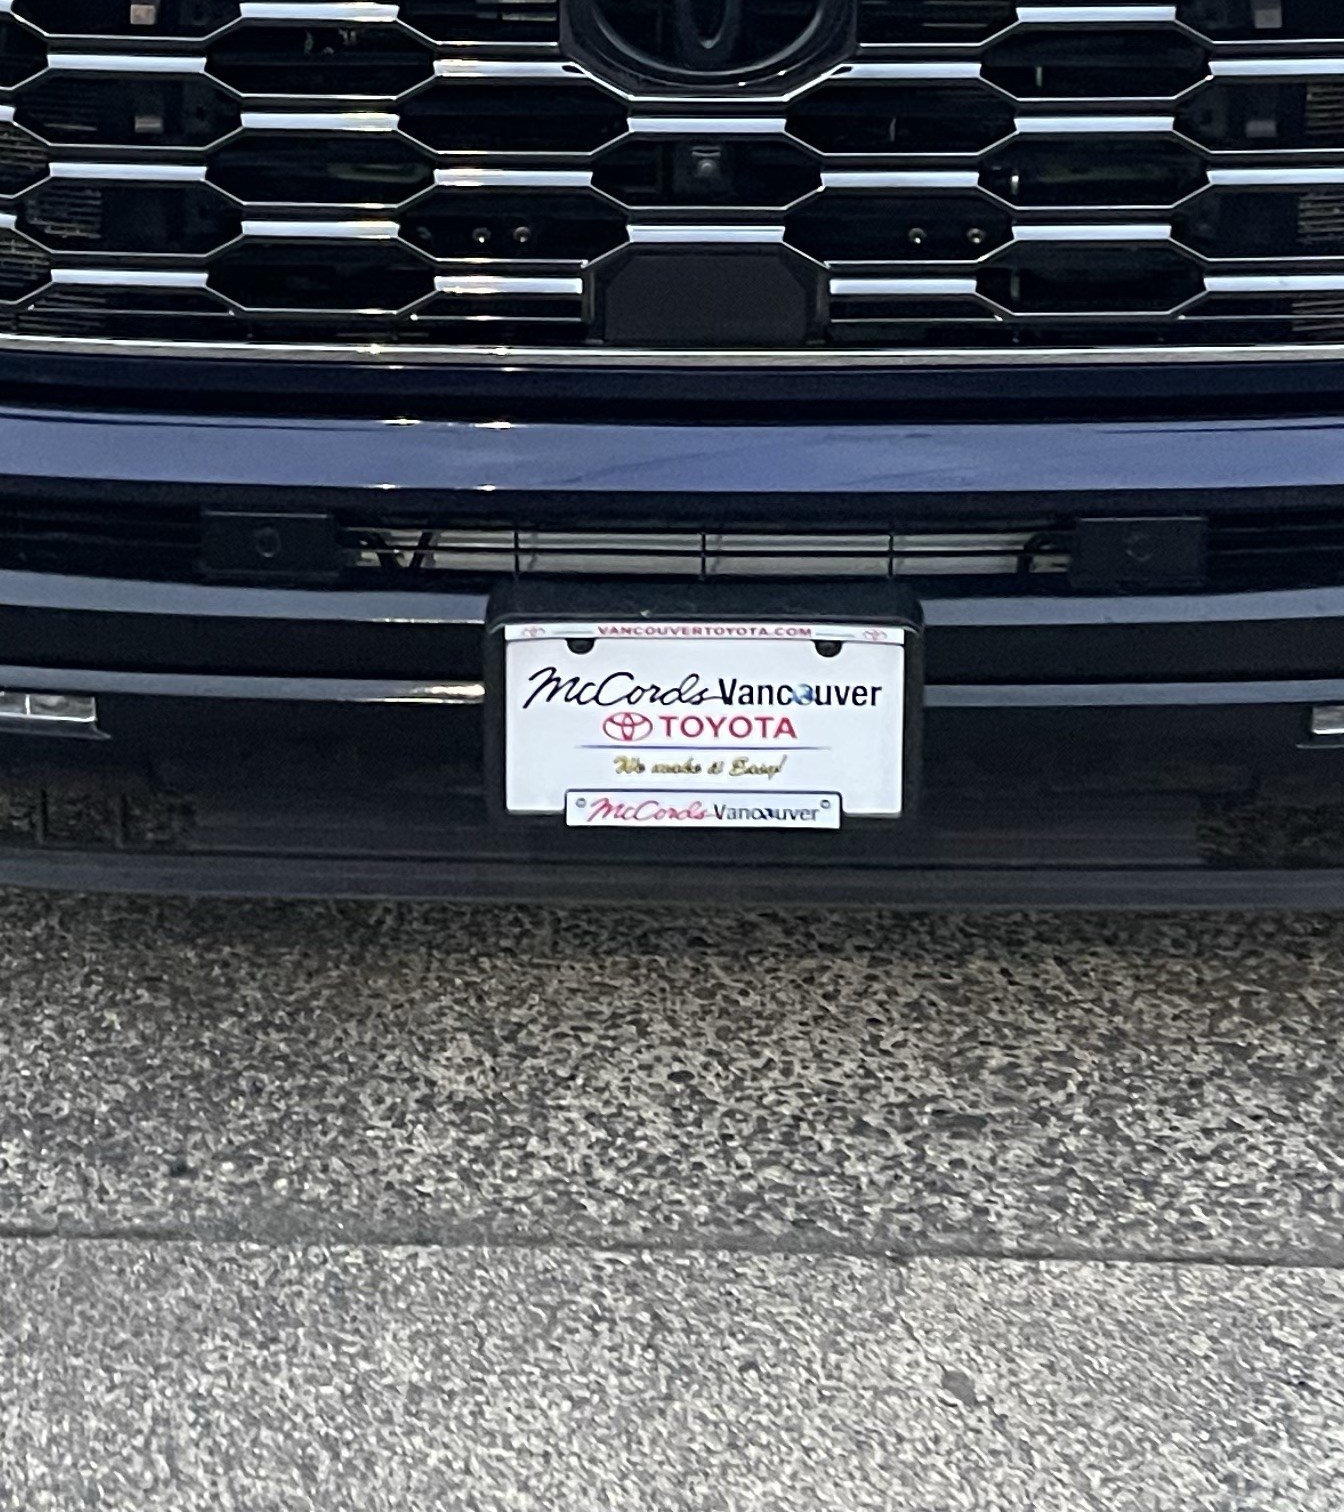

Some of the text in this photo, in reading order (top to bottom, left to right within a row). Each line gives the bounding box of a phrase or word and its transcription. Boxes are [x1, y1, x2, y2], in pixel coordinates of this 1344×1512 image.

[597, 625, 812, 637] VANCOUVERTOYOTA.COM
[522, 666, 882, 709] McCords Vancouver
[659, 715, 798, 740] TOYOTA
[613, 754, 788, 781] We make it Easy!
[586, 797, 821, 823] McCords Vancouver
